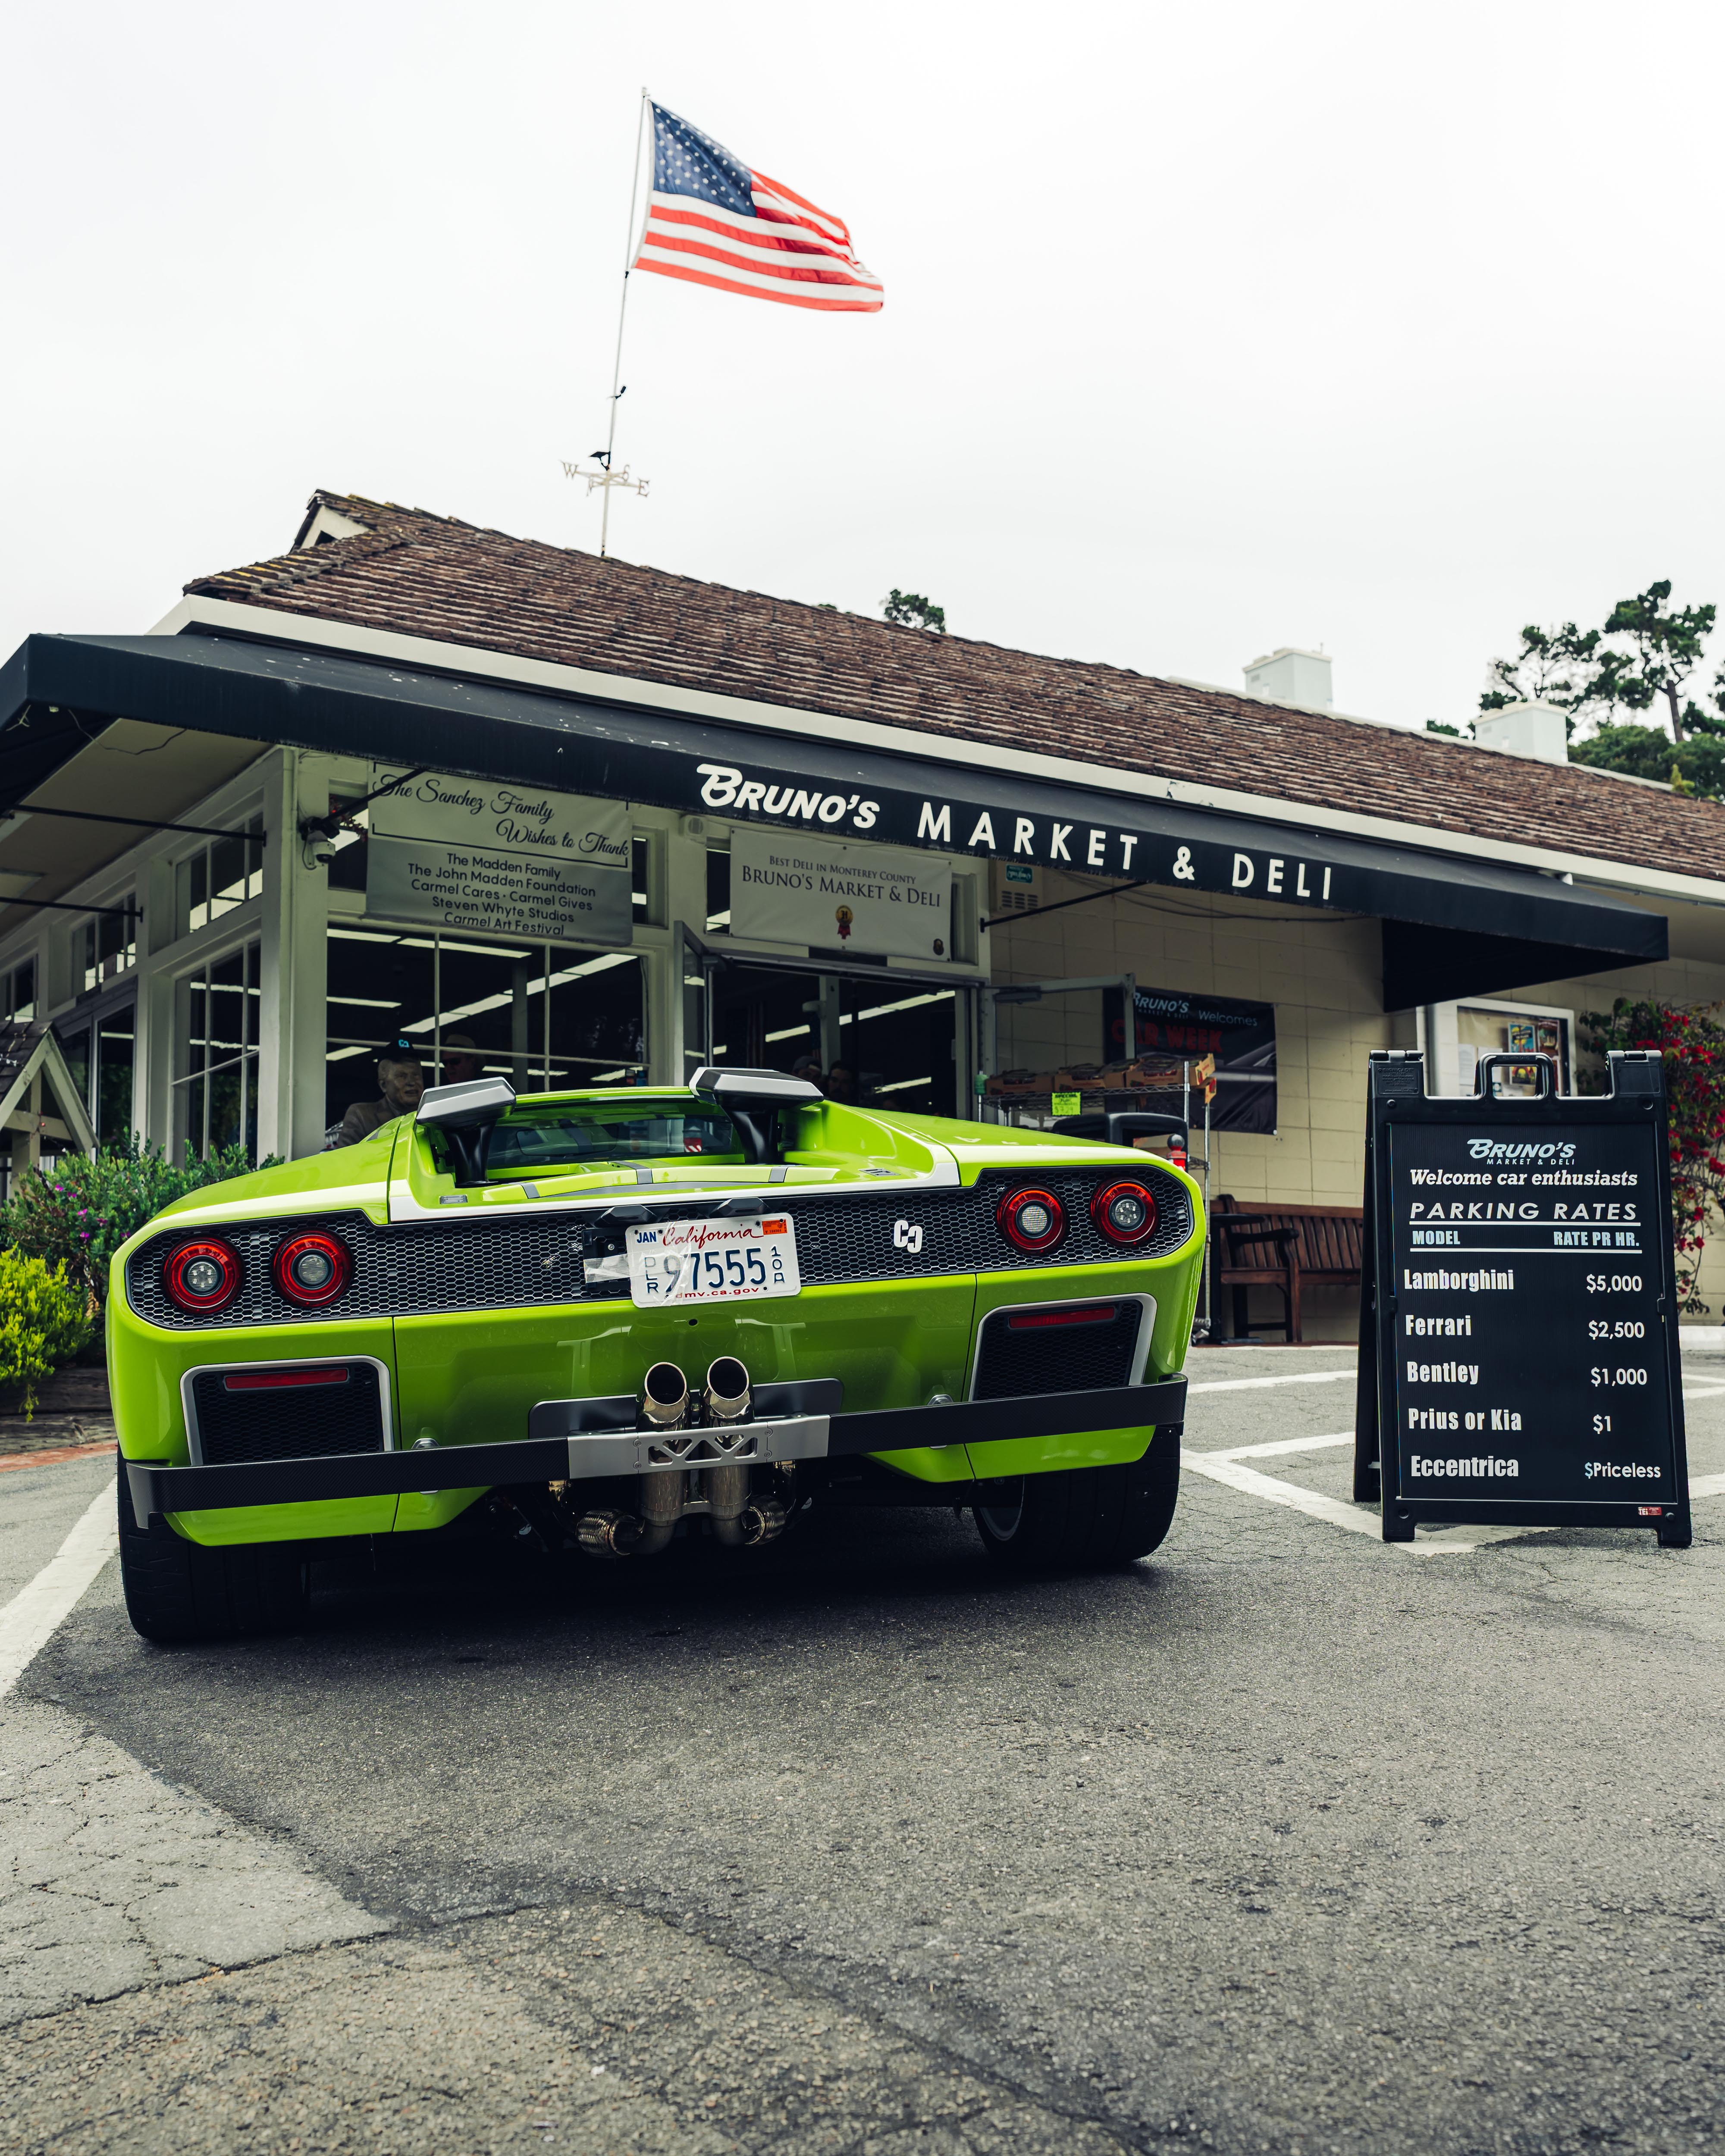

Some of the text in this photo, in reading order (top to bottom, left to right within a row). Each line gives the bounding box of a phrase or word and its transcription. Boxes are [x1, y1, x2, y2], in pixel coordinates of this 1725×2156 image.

[373, 774, 555, 824] The Sanchez Family
[496, 818, 629, 856] Wishes to Thank
[696, 763, 1331, 900] BRUNO'S MARKET & DELI
[447, 853, 561, 881] The Madden Family
[770, 856, 790, 867] BEST
[793, 859, 813, 870] DELI
[830, 864, 878, 879] MONTEREY
[879, 871, 916, 884] COUNTY
[408, 863, 596, 897] The John Madden Foundation
[742, 865, 940, 907] BRUNO'S MARKET & DELI
[411, 879, 593, 911] Carmel Cares Carmel Gives
[433, 896, 574, 922] Steven Whyte Studios
[444, 912, 490, 927] Carmel
[493, 918, 512, 930] Art
[515, 920, 564, 935] Festival
[1198, 1010, 1258, 1027] Welcomes
[1165, 1024, 1223, 1053] WEEK
[1467, 1139, 1576, 1159] BRUNO'S
[1410, 1169, 1637, 1186] Welcome car enthusiasts
[1410, 1203, 1637, 1220] PARKING RATES
[637, 1232, 656, 1244] JAN
[662, 1224, 764, 1249] California
[1412, 1231, 1640, 1246] MODEL RATE PR HR.
[663, 1248, 766, 1293] 97555
[1404, 1269, 1642, 1293] Lamborghini $5,000
[676, 1287, 759, 1298] dmv.ca.gov
[1405, 1315, 1645, 1340] Ferrari $2,500
[1407, 1361, 1647, 1386] Bentley $1,000
[1408, 1408, 1611, 1434] Prius or Kia $1
[1411, 1456, 1661, 1479] Eccentrica $Priceless
